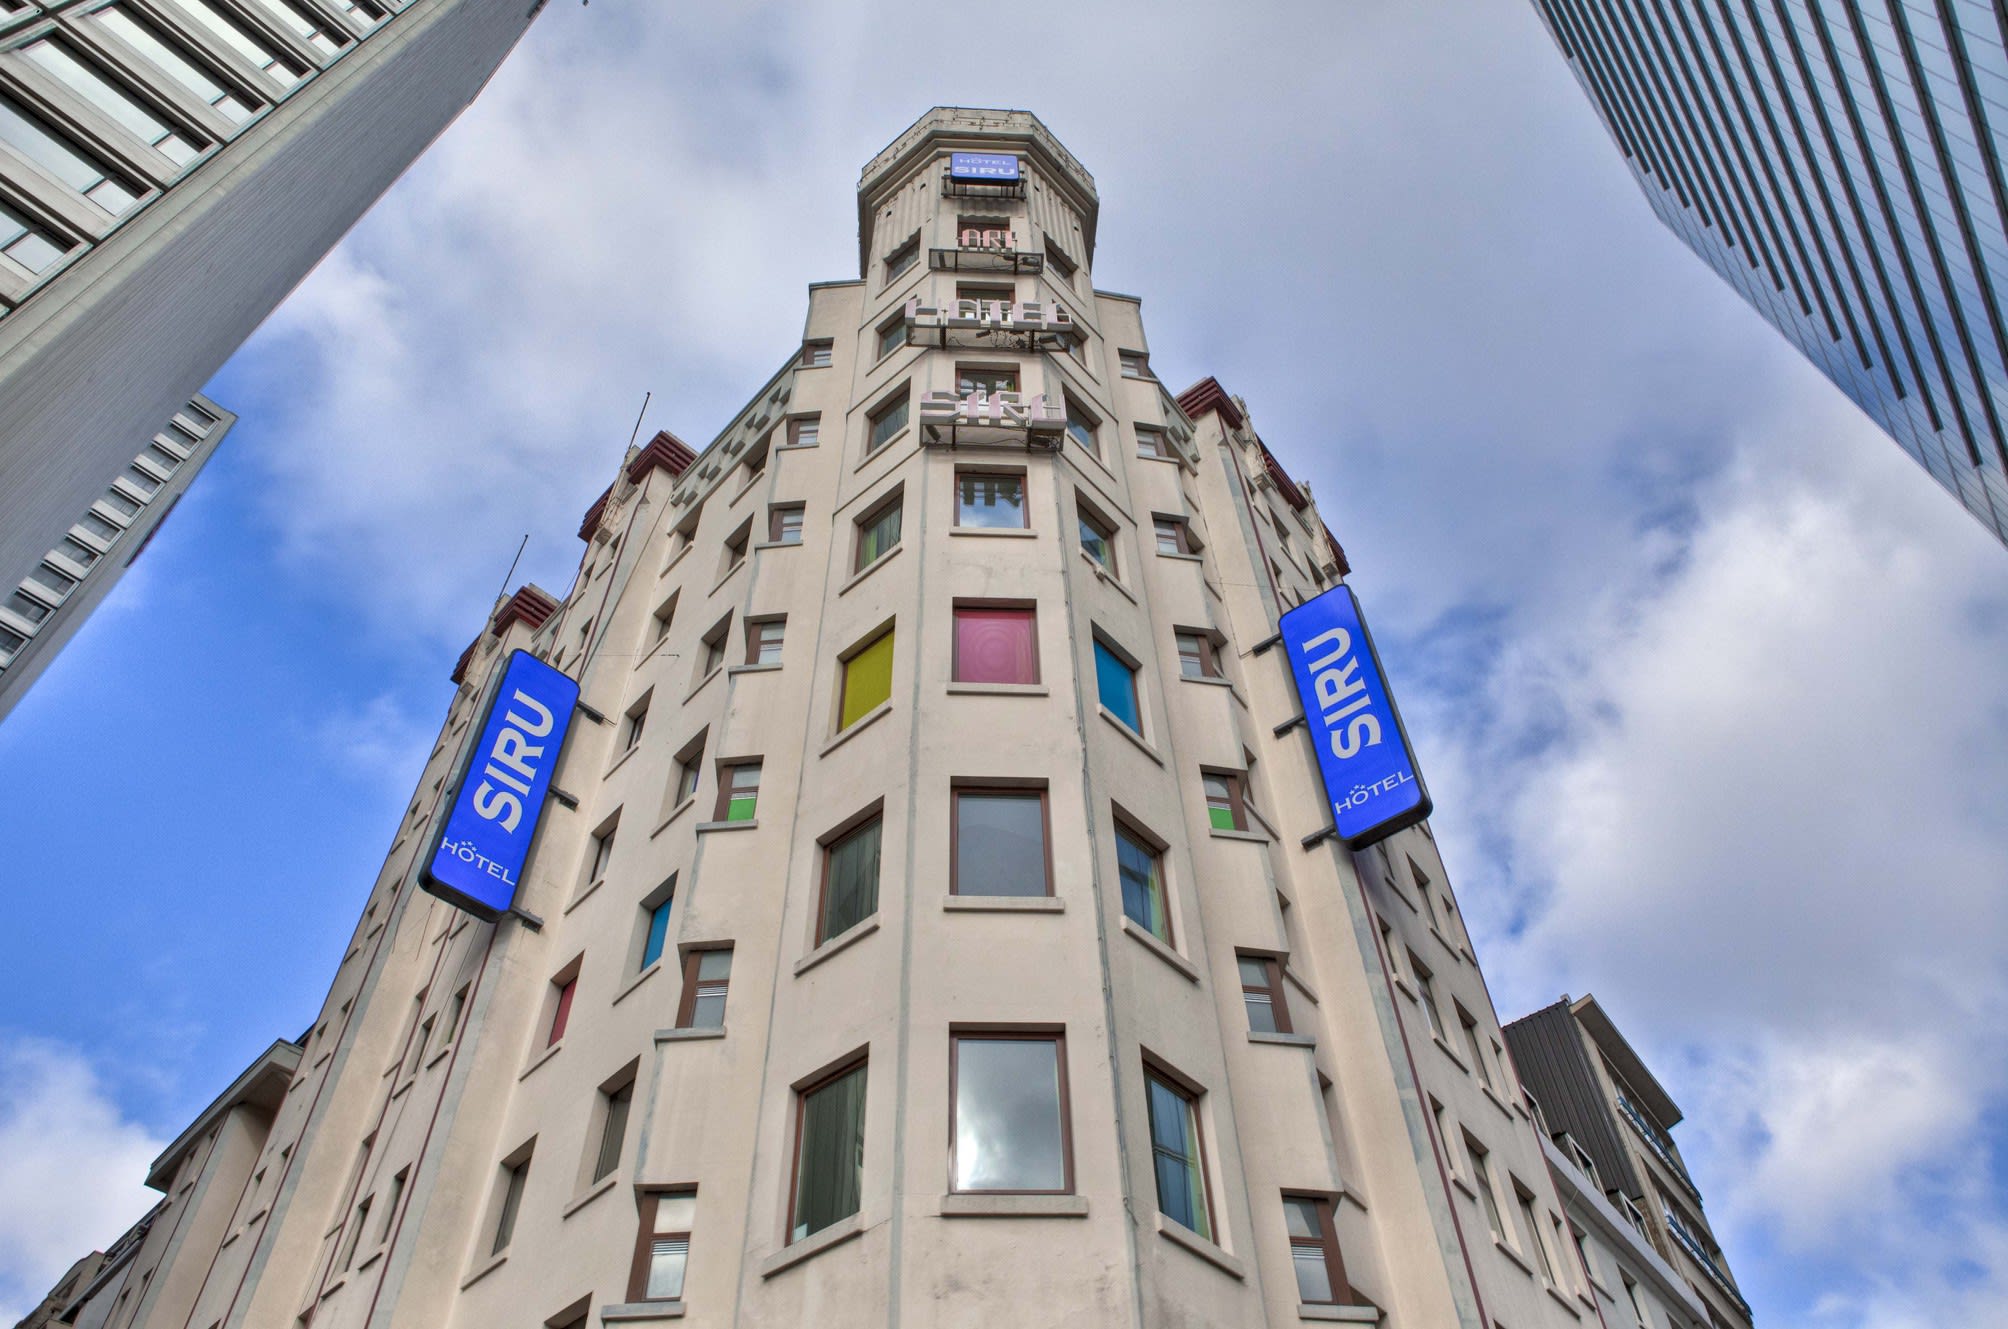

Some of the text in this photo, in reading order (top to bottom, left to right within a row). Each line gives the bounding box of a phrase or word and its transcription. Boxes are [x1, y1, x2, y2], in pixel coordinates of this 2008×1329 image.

[954, 166, 1015, 175] SIRU
[920, 390, 1067, 430] SIRU
[1301, 627, 1382, 759] SIRU
[472, 688, 554, 834] SIRU
